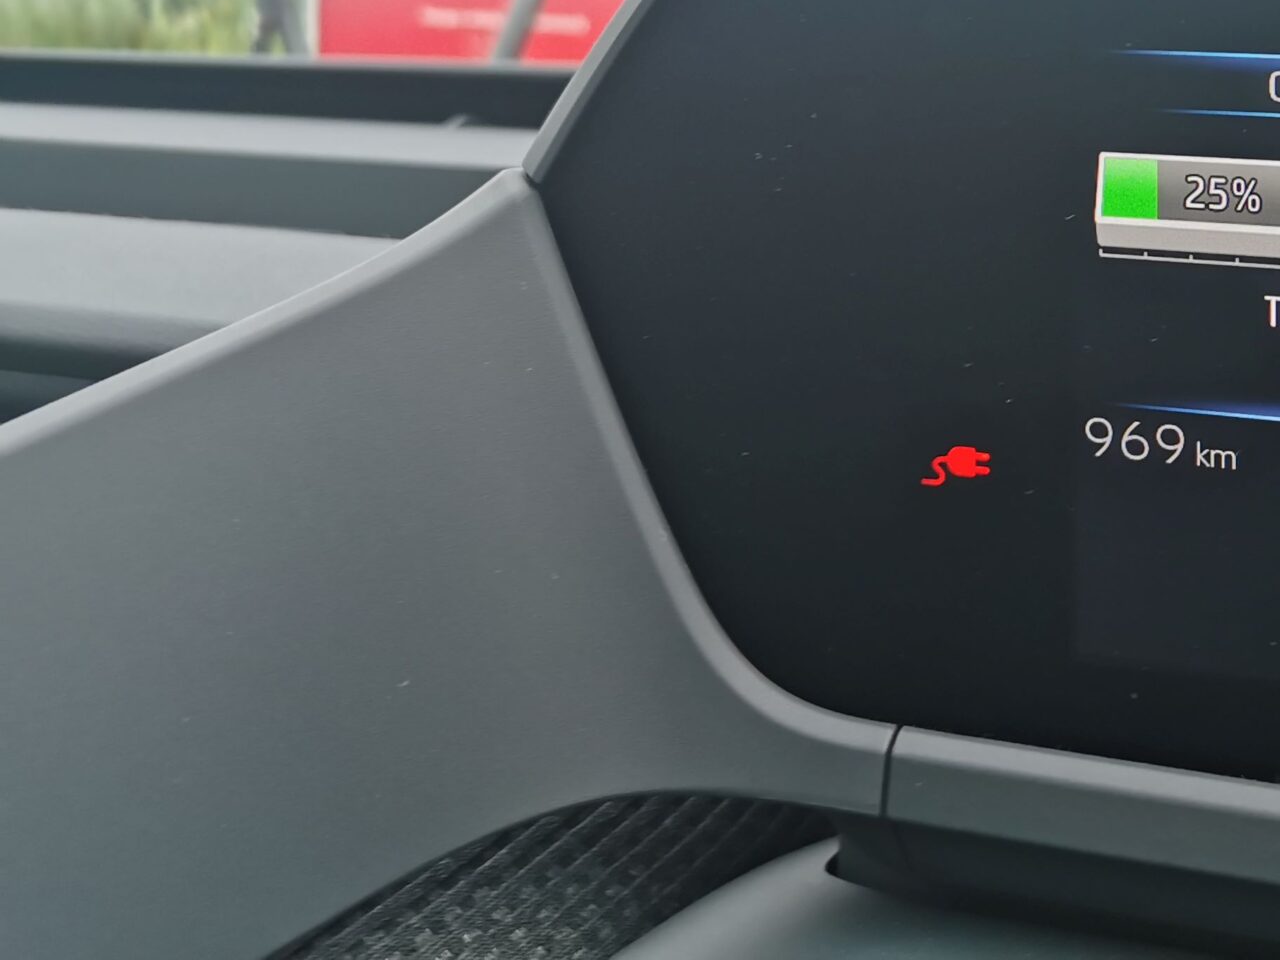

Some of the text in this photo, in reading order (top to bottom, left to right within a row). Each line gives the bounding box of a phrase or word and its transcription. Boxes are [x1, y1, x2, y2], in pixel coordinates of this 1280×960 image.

[1183, 174, 1263, 214] 25%
[1085, 417, 1238, 471] 969 km
